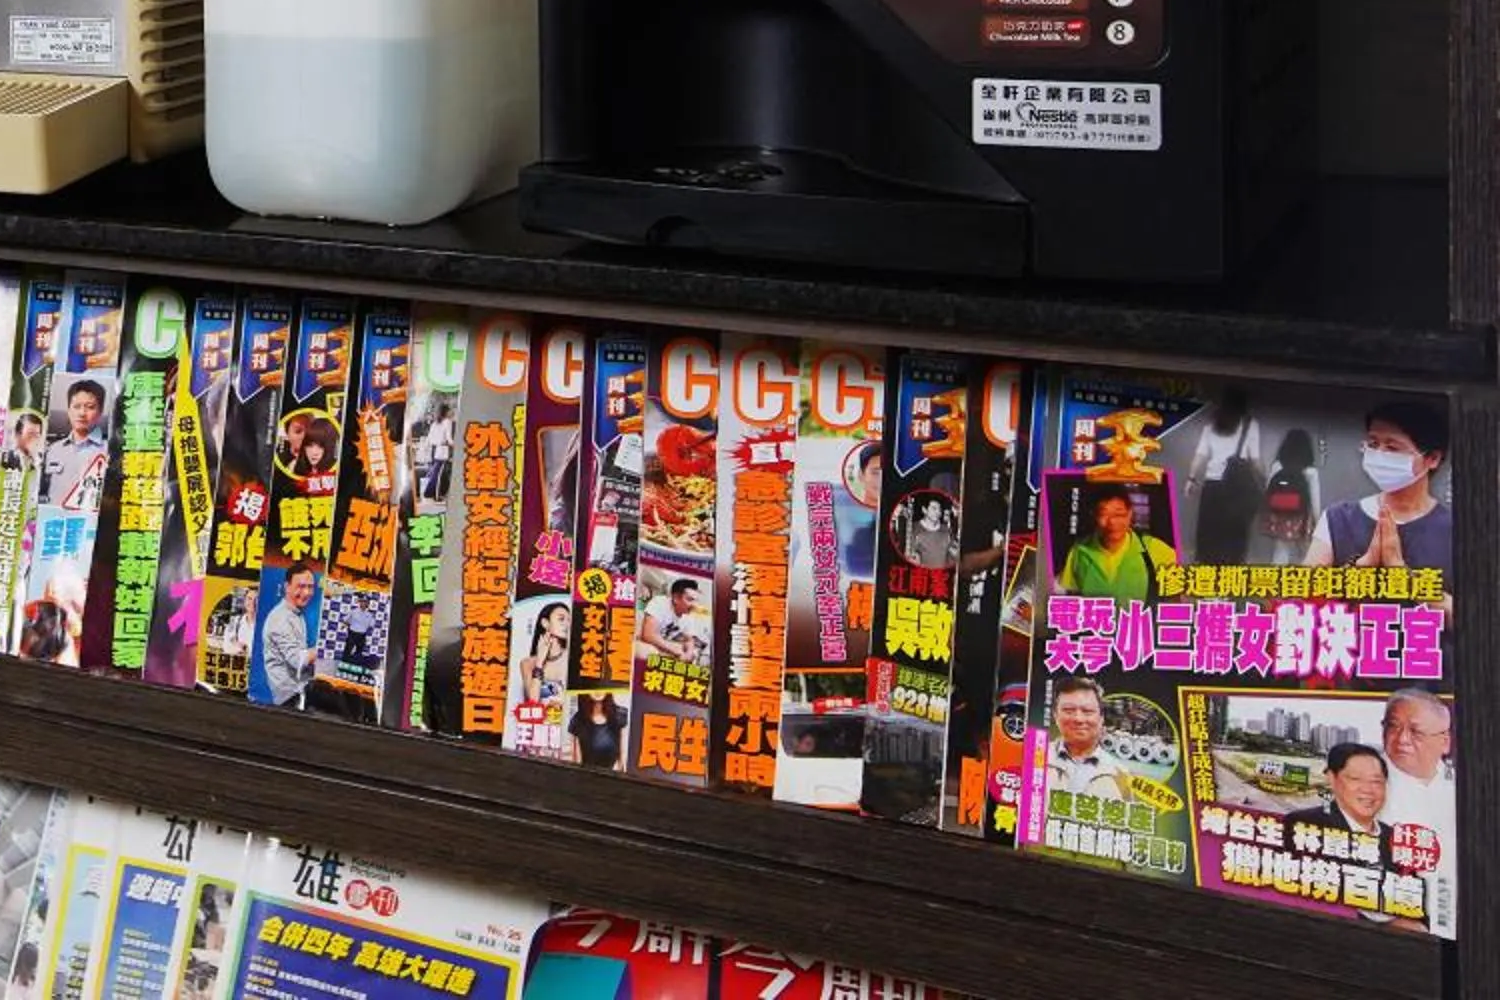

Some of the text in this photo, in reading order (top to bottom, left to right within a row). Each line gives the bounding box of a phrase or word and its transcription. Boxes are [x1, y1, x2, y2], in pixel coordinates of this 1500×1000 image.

[1040, 33, 1062, 42] Milk
[1073, 418, 1096, 464] 周刊
[1156, 565, 1444, 600] 慘遭撕票留鉅額遺產
[1048, 595, 1116, 634] 電玩
[1044, 633, 1115, 674] 大亨
[1114, 599, 1445, 680] 小三攜女對決正宮
[293, 845, 344, 905] 雄
[258, 915, 353, 960] 合併四年
